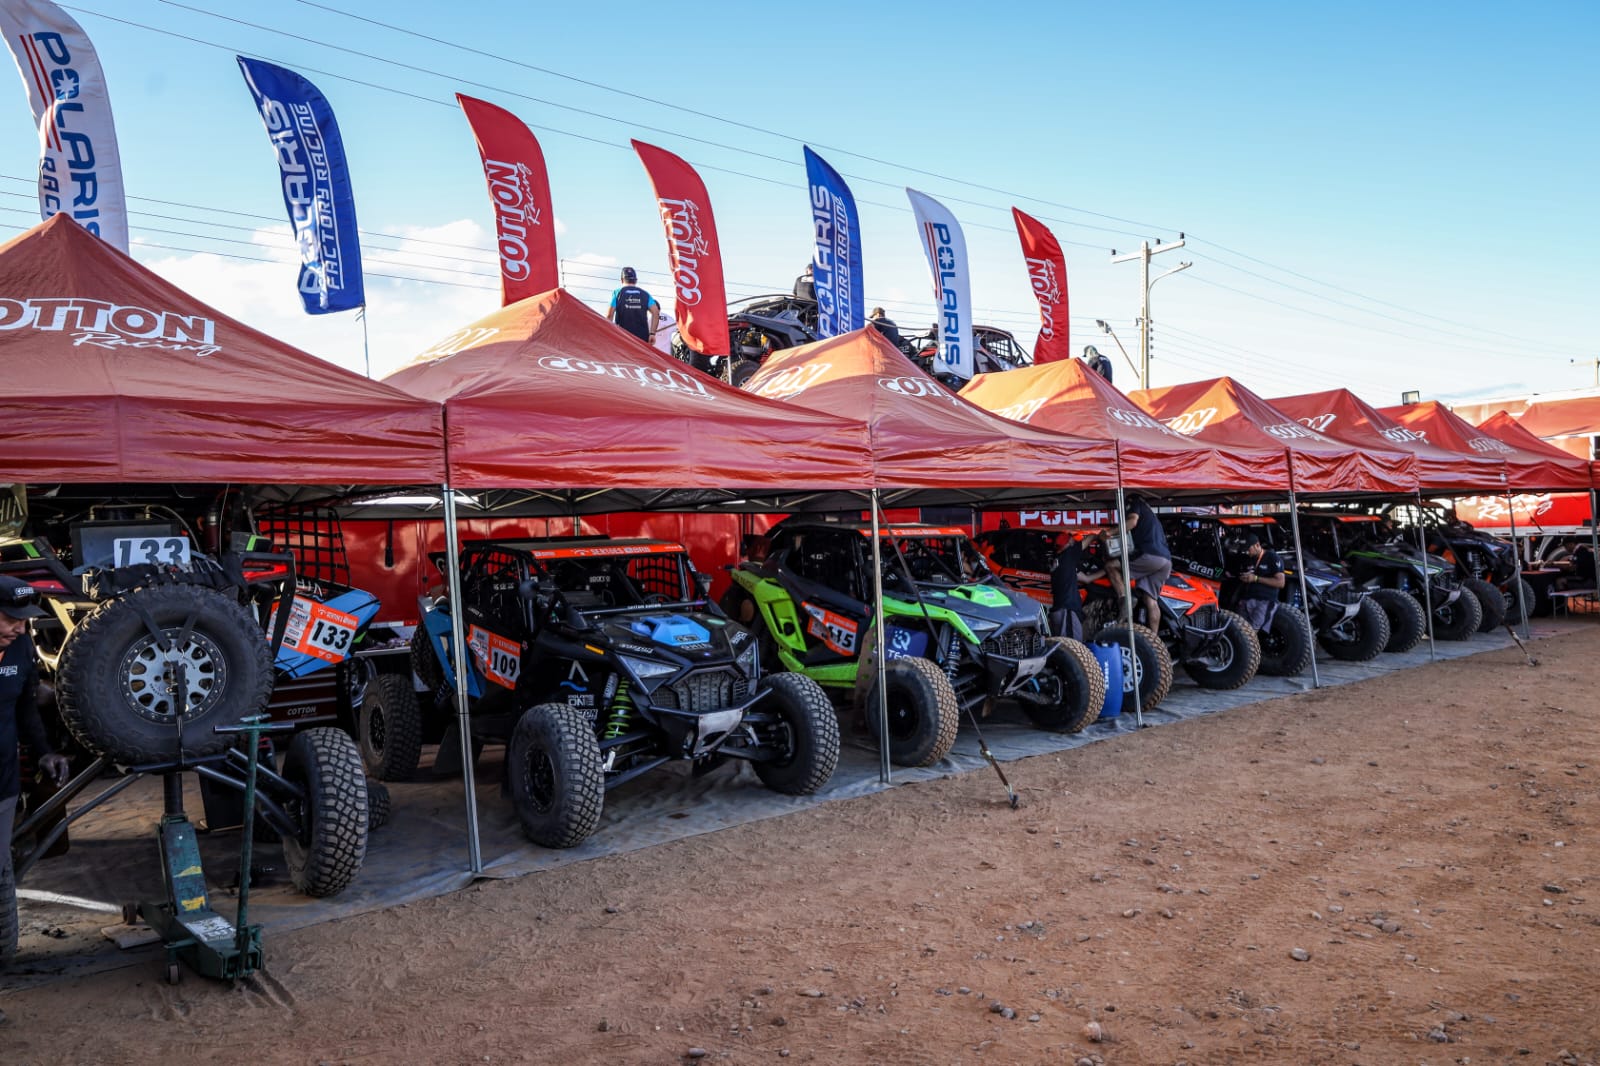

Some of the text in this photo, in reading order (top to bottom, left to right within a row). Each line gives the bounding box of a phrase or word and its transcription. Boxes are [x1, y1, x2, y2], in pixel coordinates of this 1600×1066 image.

[296, 103, 341, 290] FACTORY RACING
[486, 159, 530, 282] COTTON
[658, 197, 703, 306] COTTON
[811, 184, 834, 340] POLARIS
[837, 262, 850, 338] ACTORY
[933, 222, 961, 367] POLARIS
[70, 331, 222, 357] Racing
[538, 356, 708, 396] COTTON
[119, 538, 185, 569] 133
[1189, 561, 1214, 576] Gran
[312, 620, 350, 650] 133
[828, 625, 854, 648] 115
[492, 651, 517, 677] 109
[287, 704, 318, 716] COTTON
